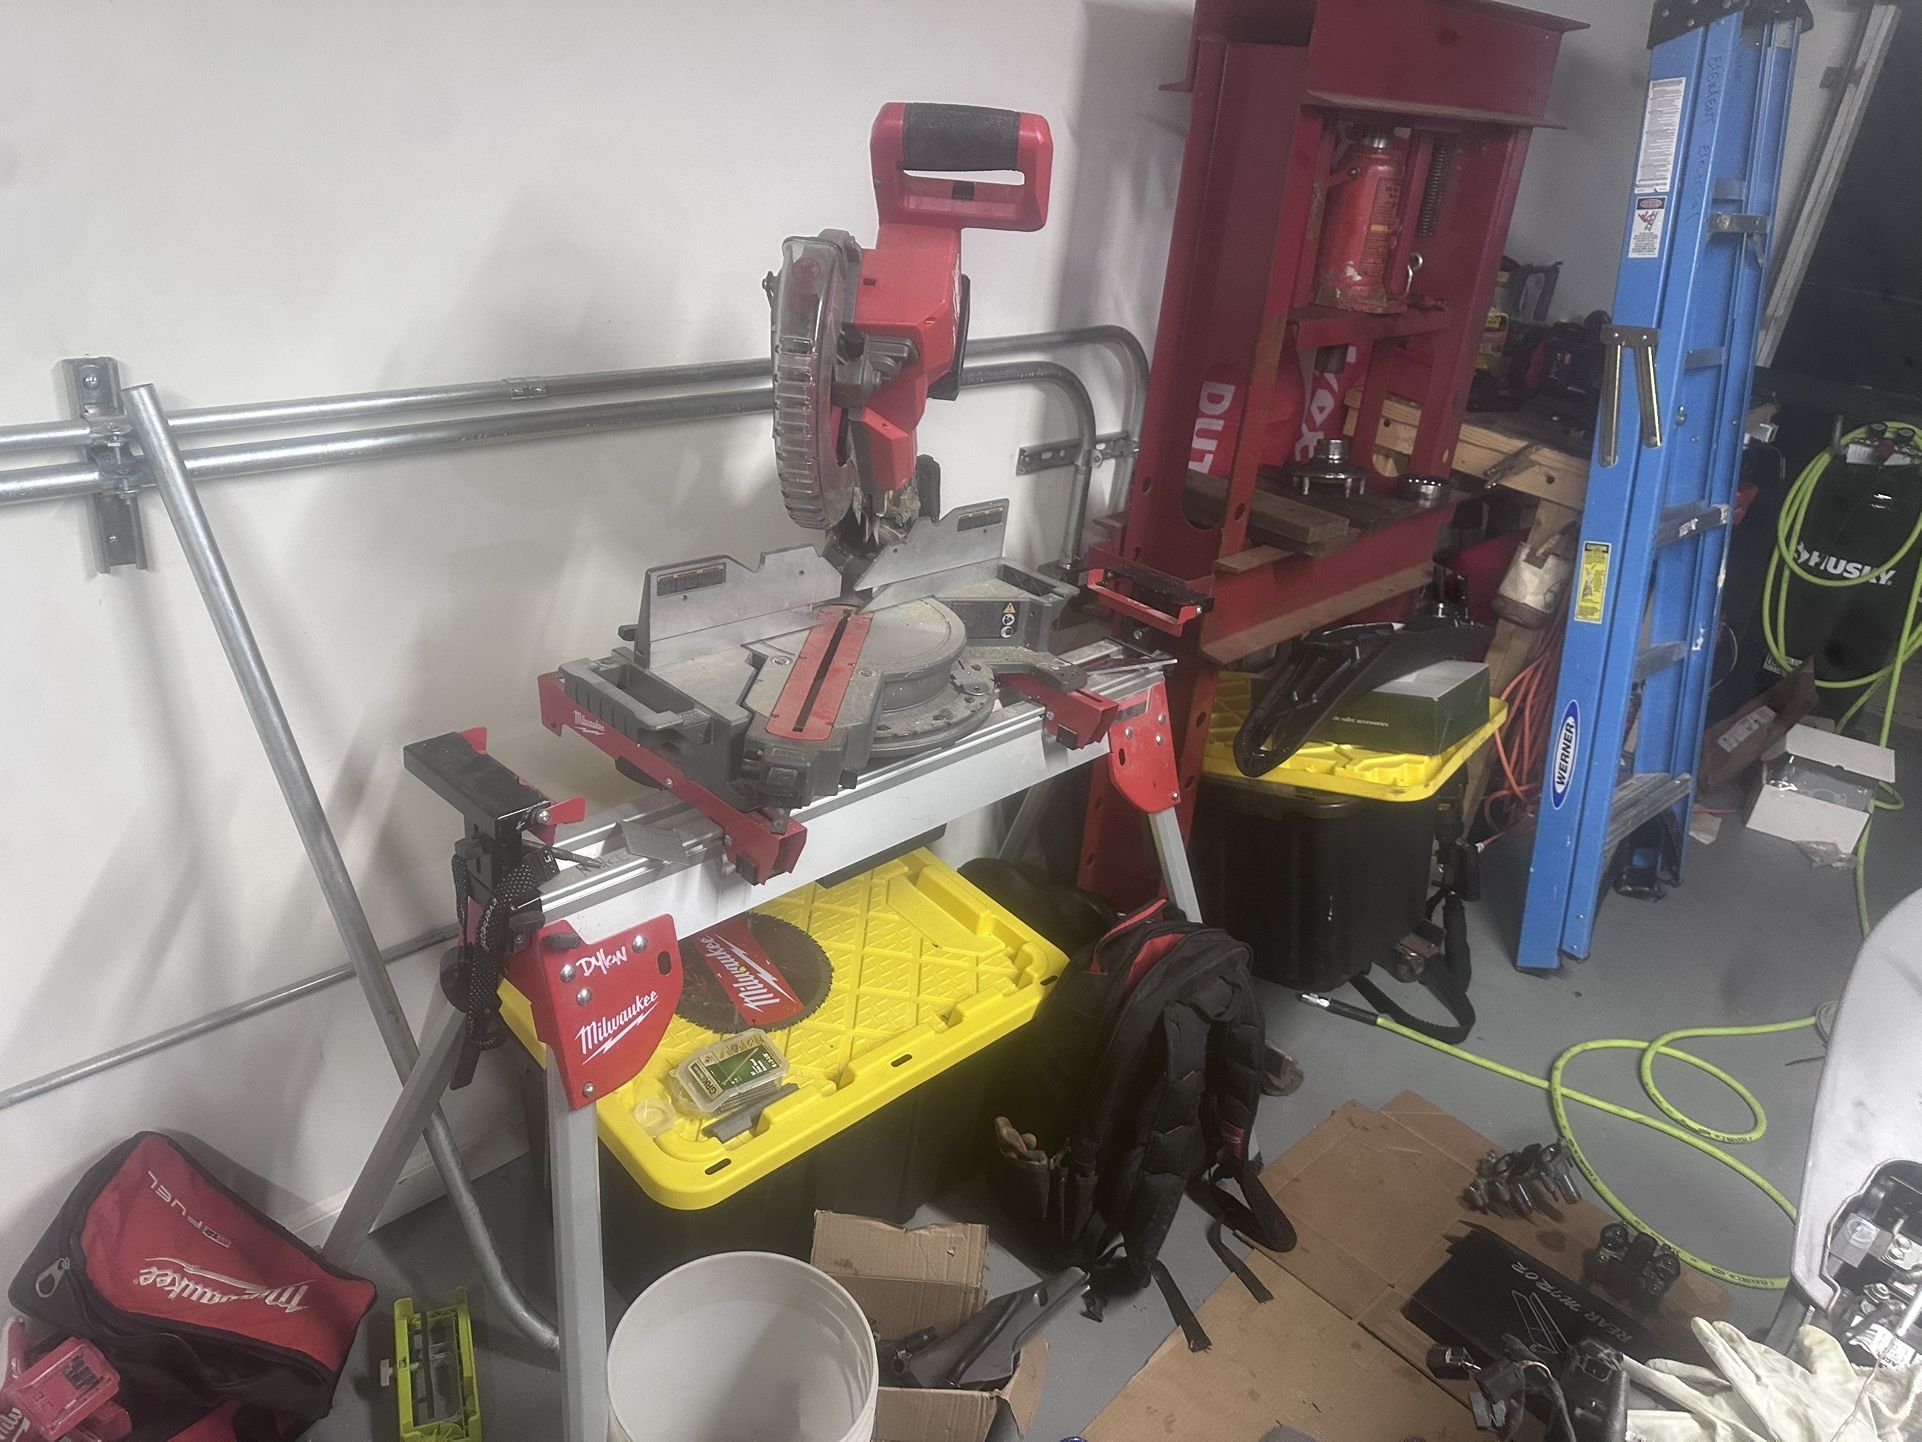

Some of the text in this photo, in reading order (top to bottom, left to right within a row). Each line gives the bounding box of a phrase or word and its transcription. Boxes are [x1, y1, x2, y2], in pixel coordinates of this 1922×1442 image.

[1556, 722, 1575, 786] WERNER
[701, 935, 780, 1013] Milwaukee
[575, 990, 659, 1055] Milwaukee
[147, 1170, 203, 1230] FUEL
[138, 1267, 310, 1313] Mwaukee
[1584, 1311, 1633, 1343] REAR
